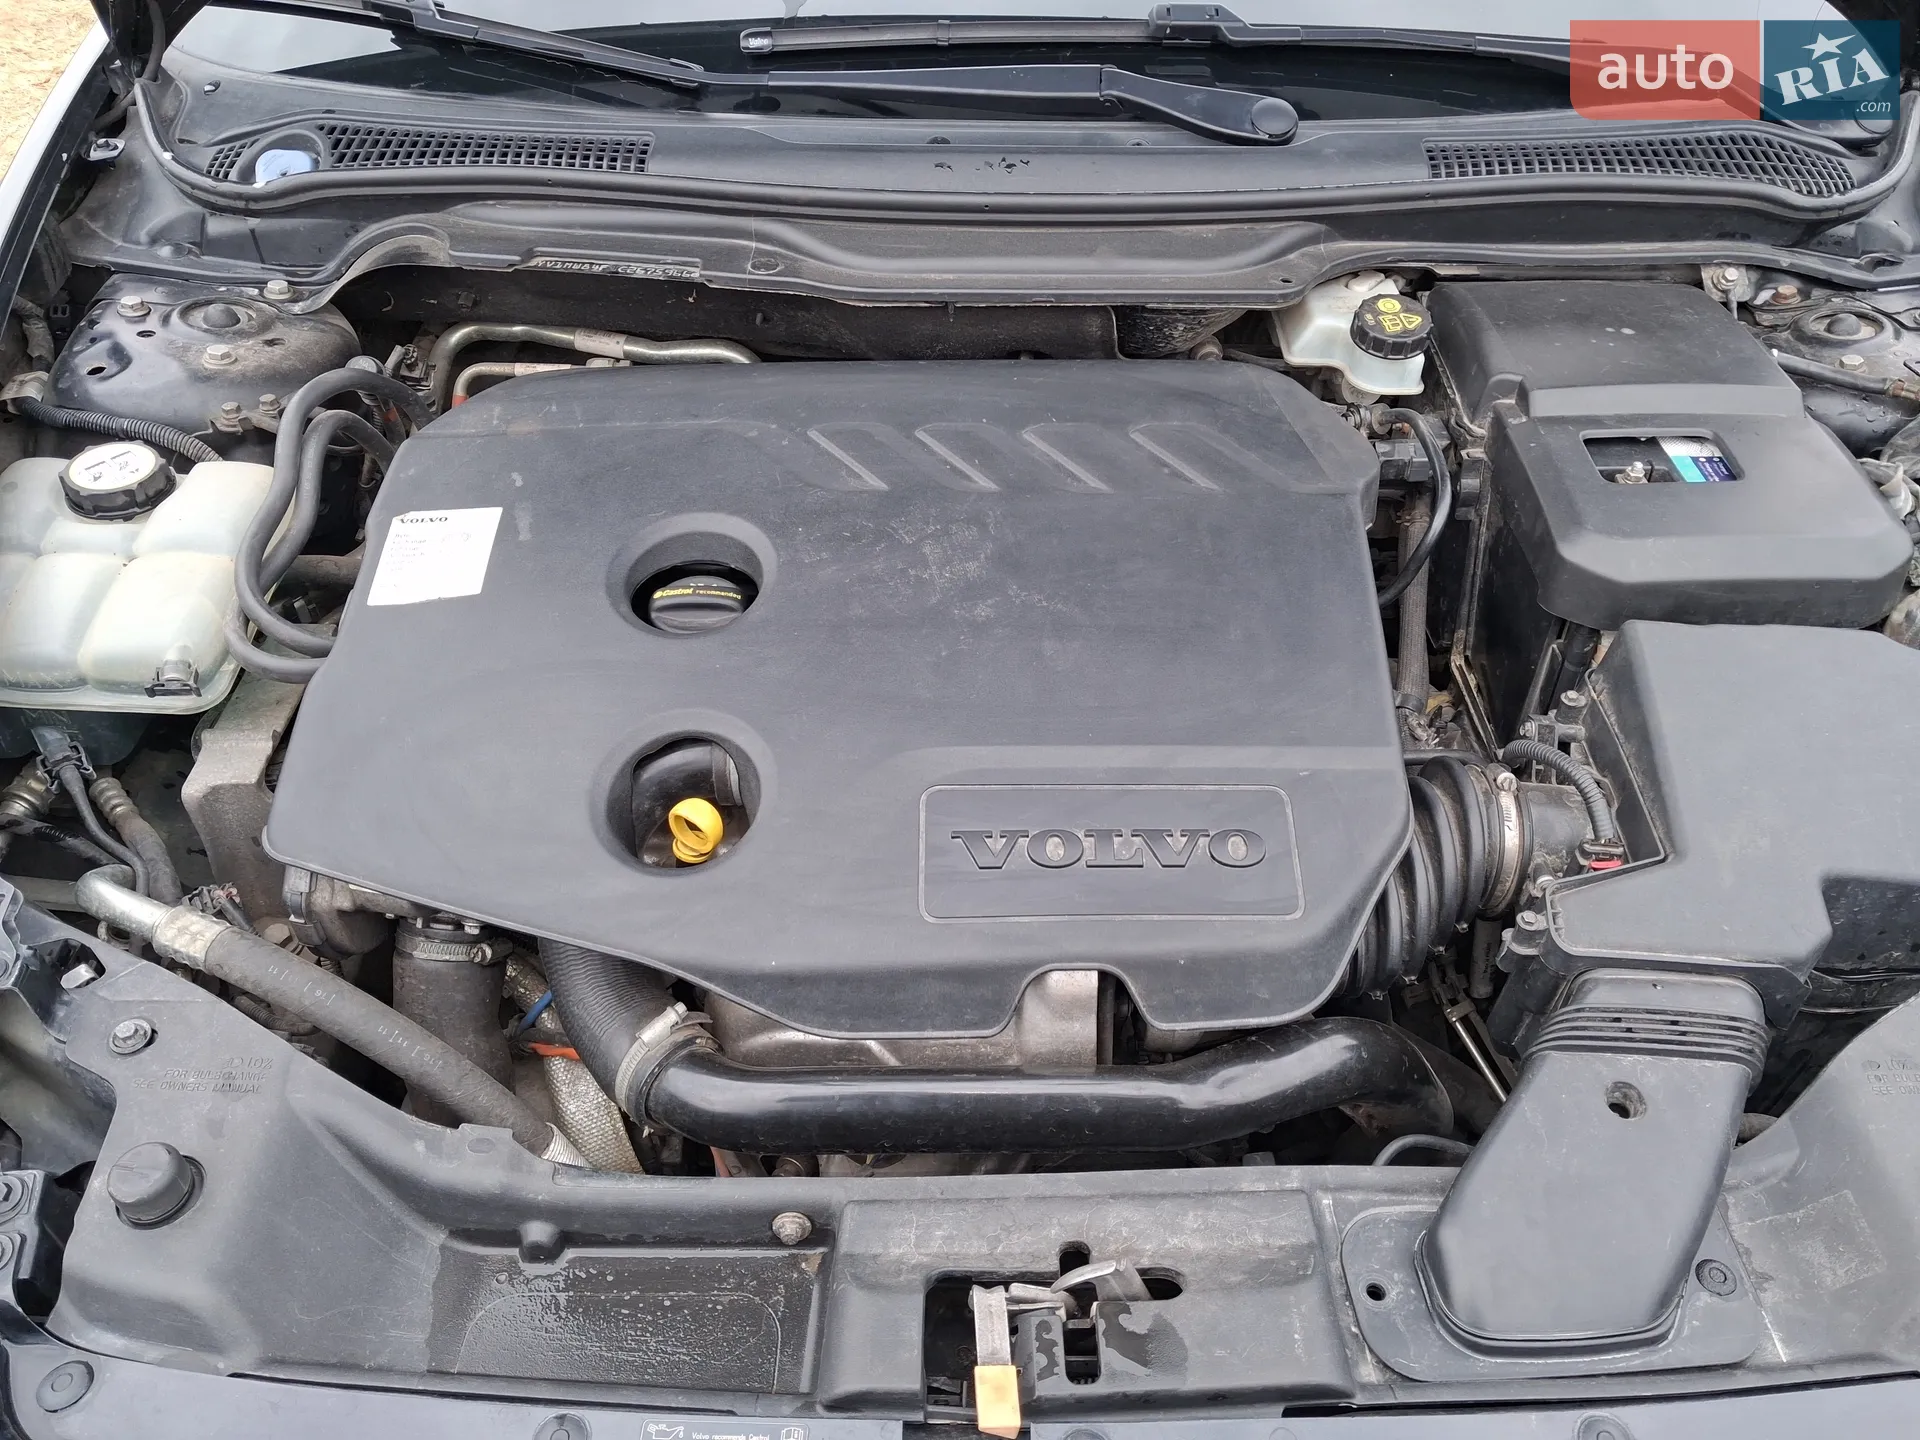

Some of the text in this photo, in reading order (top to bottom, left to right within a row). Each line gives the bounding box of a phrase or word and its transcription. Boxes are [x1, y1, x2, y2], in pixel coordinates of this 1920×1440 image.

[399, 515, 449, 525] VOLVO
[662, 587, 694, 597] Castrol
[950, 828, 1267, 870] VOLVO
[163, 1068, 188, 1079] FOR
